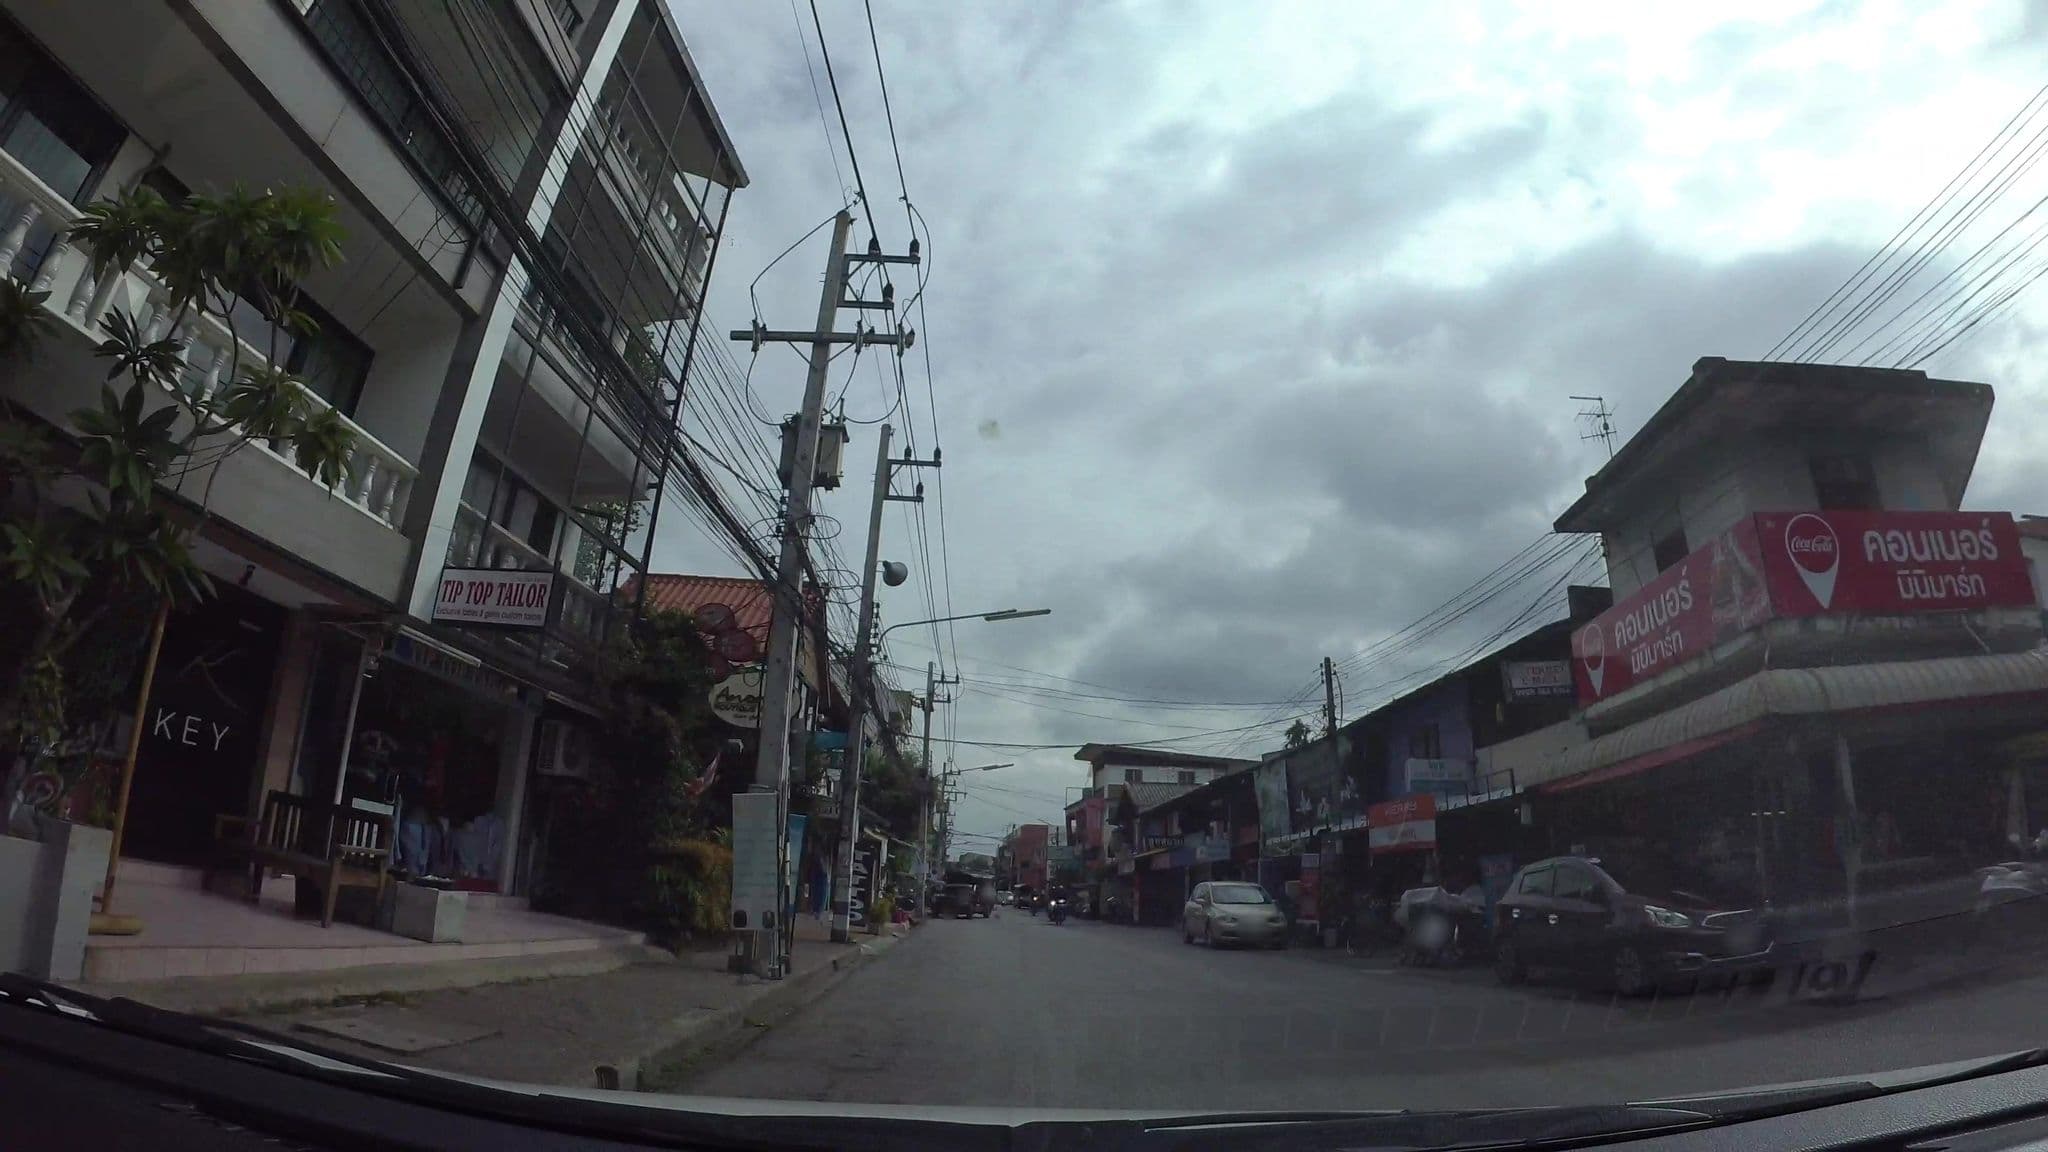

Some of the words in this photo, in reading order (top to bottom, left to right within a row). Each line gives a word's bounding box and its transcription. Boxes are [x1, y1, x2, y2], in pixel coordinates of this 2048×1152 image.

[1863, 518, 1999, 562] คอนเนอร์
[441, 580, 464, 603] TIP
[466, 581, 494, 605] TOP
[496, 582, 548, 608] TAILOR
[153, 707, 230, 752] KEY
